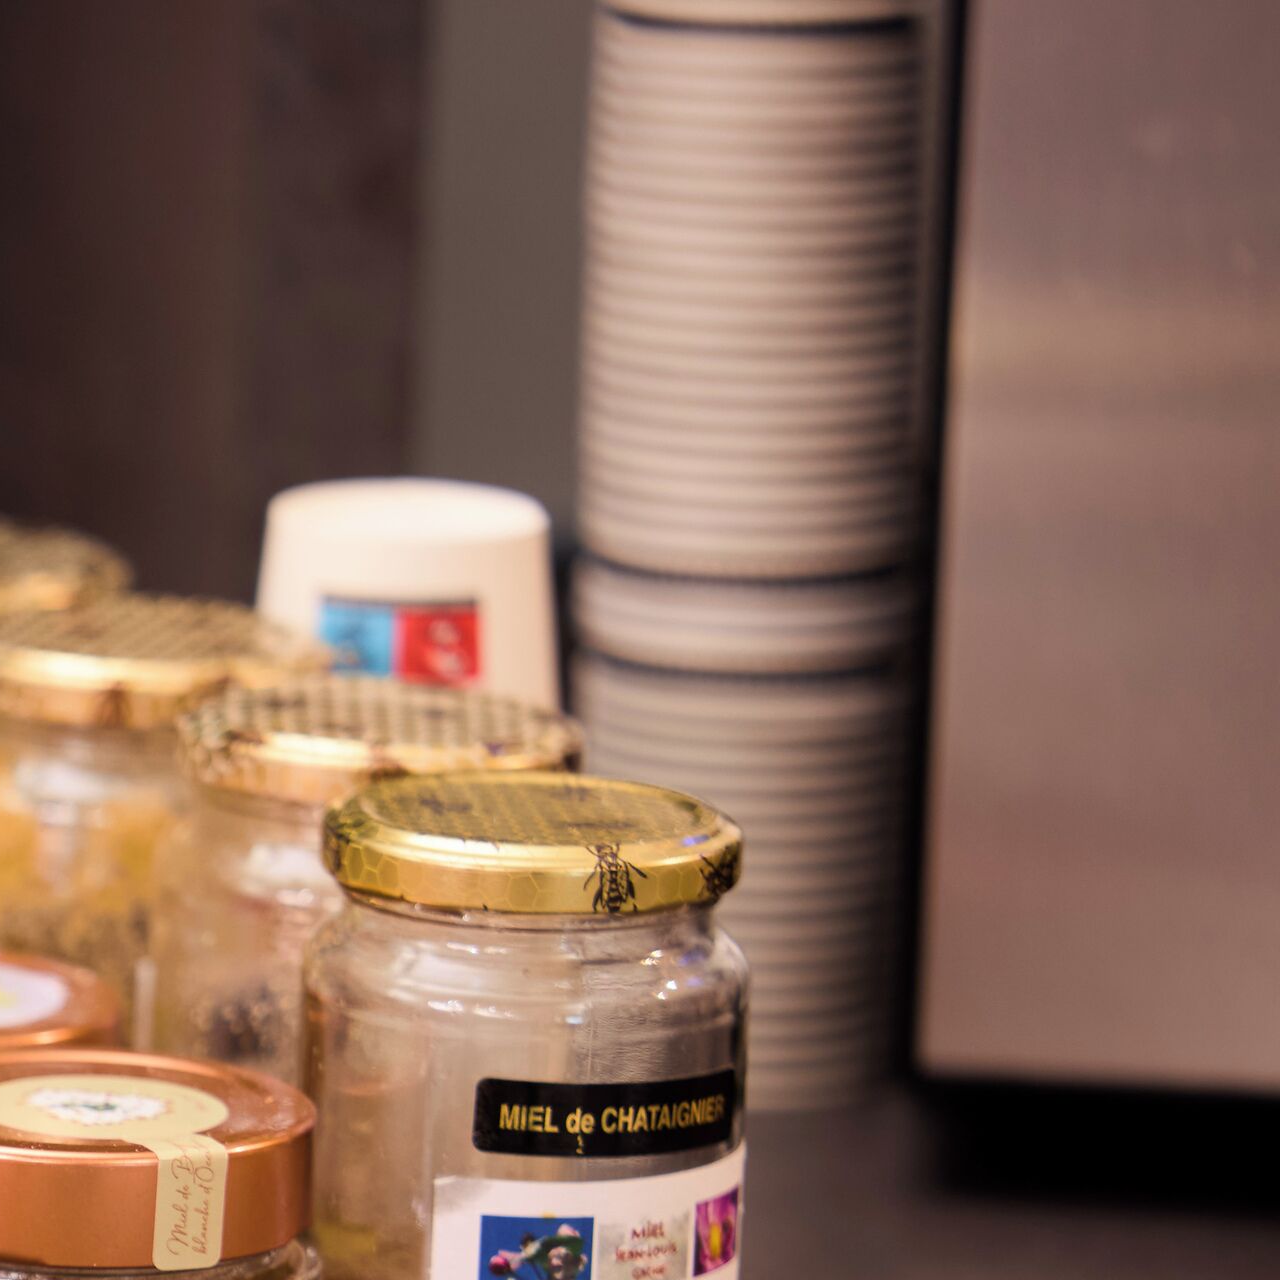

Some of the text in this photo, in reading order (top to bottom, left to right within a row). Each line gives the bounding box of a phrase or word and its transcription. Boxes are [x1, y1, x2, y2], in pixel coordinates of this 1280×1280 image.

[499, 1095, 725, 1134] MIEL de CHATAIGNIER
[166, 1204, 189, 1255] Miel
